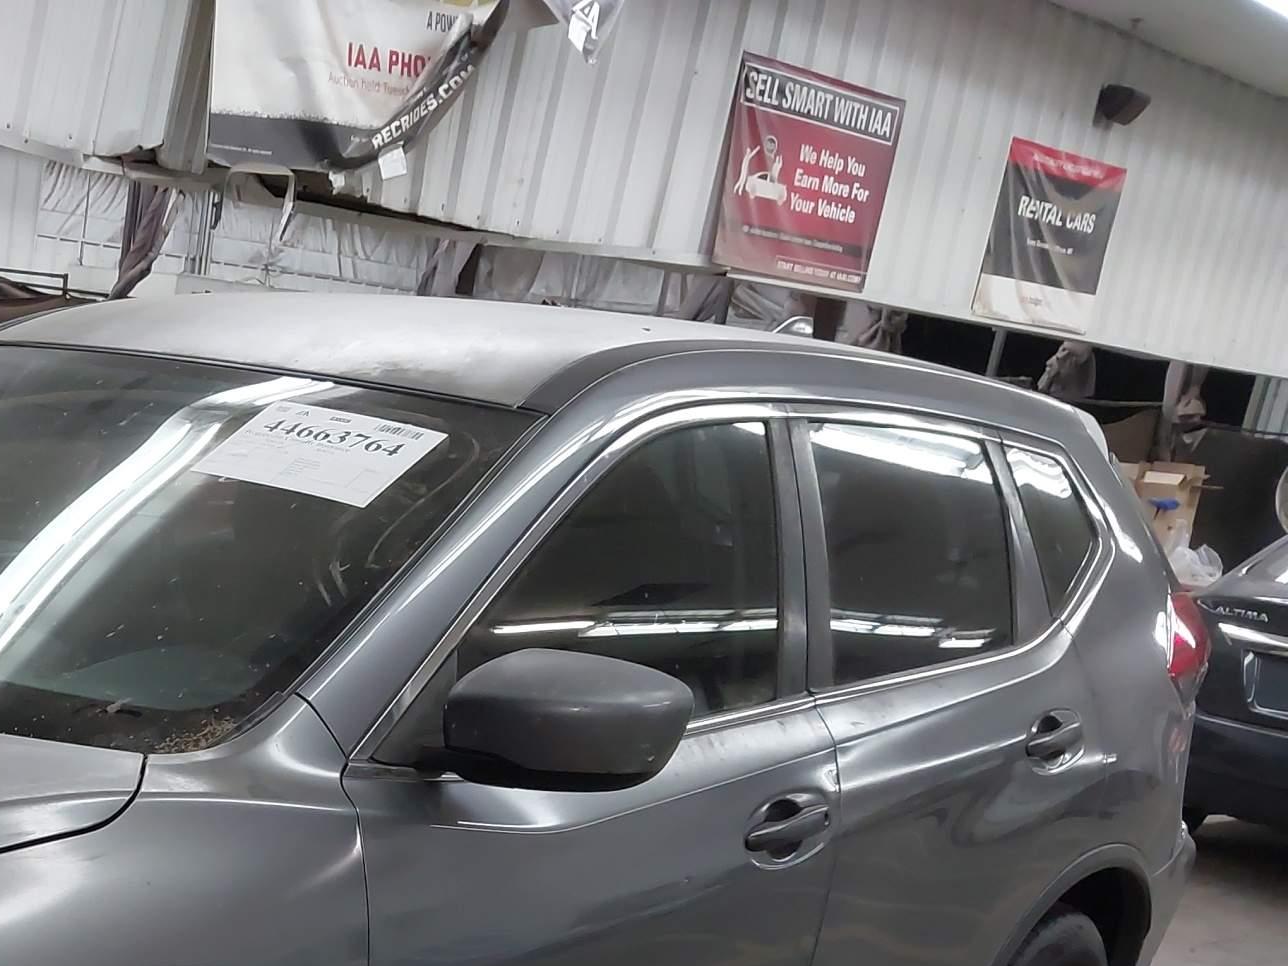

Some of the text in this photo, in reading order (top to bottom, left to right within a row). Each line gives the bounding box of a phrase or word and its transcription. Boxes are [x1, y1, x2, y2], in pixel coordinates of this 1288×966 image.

[427, 10, 458, 33] A POW
[347, 42, 431, 79] IAA PHO
[745, 71, 892, 138] SELL SMART WITH IAA
[799, 144, 866, 177] We Help You
[794, 169, 870, 203] Earn More For
[790, 192, 856, 223] Your Vehicle
[1017, 195, 1097, 234] RENTAL CARS
[263, 418, 406, 457] 44663764
[1215, 605, 1269, 623] ALTIMA
